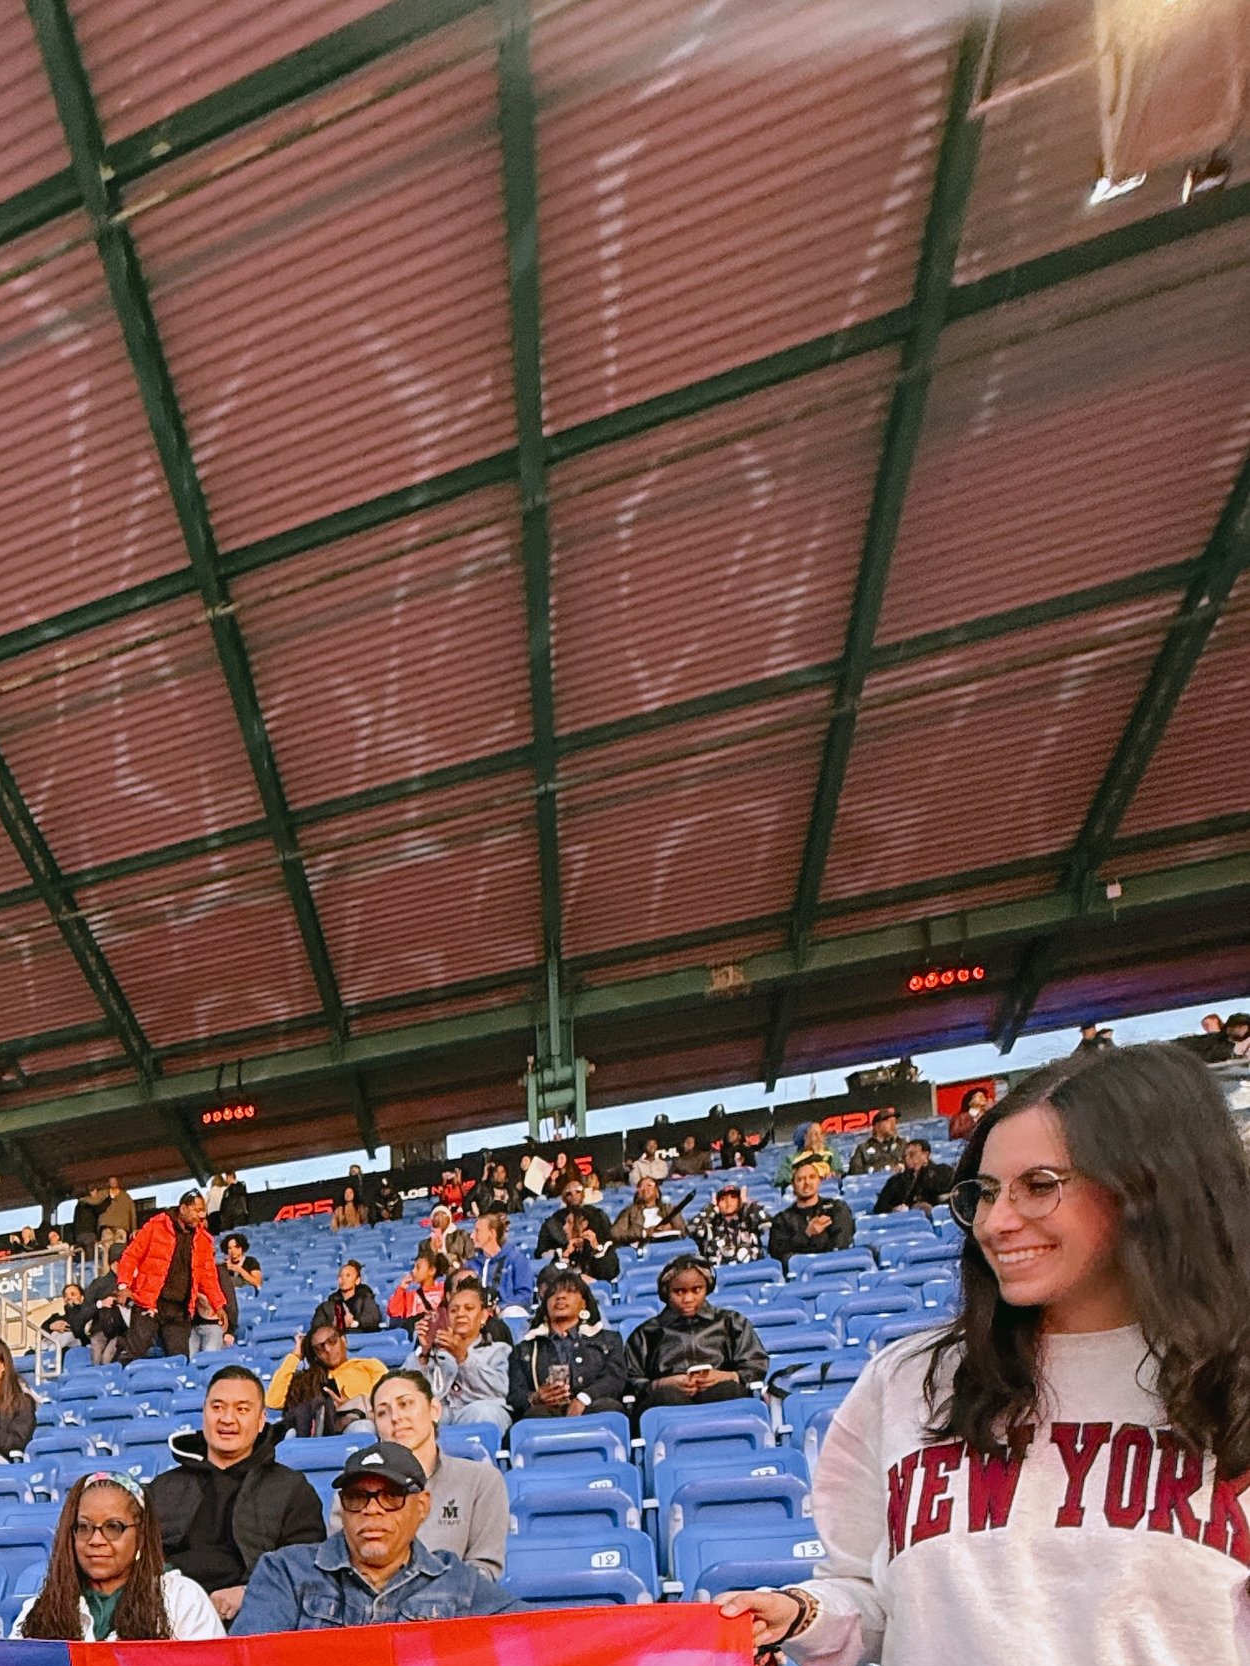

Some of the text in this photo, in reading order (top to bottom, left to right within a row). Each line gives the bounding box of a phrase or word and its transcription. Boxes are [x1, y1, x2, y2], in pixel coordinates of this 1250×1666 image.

[275, 1199, 334, 1221] A25
[886, 1421, 1250, 1570] NEW YORK
[800, 1543, 820, 1557] 13
[597, 1553, 616, 1566] 12
